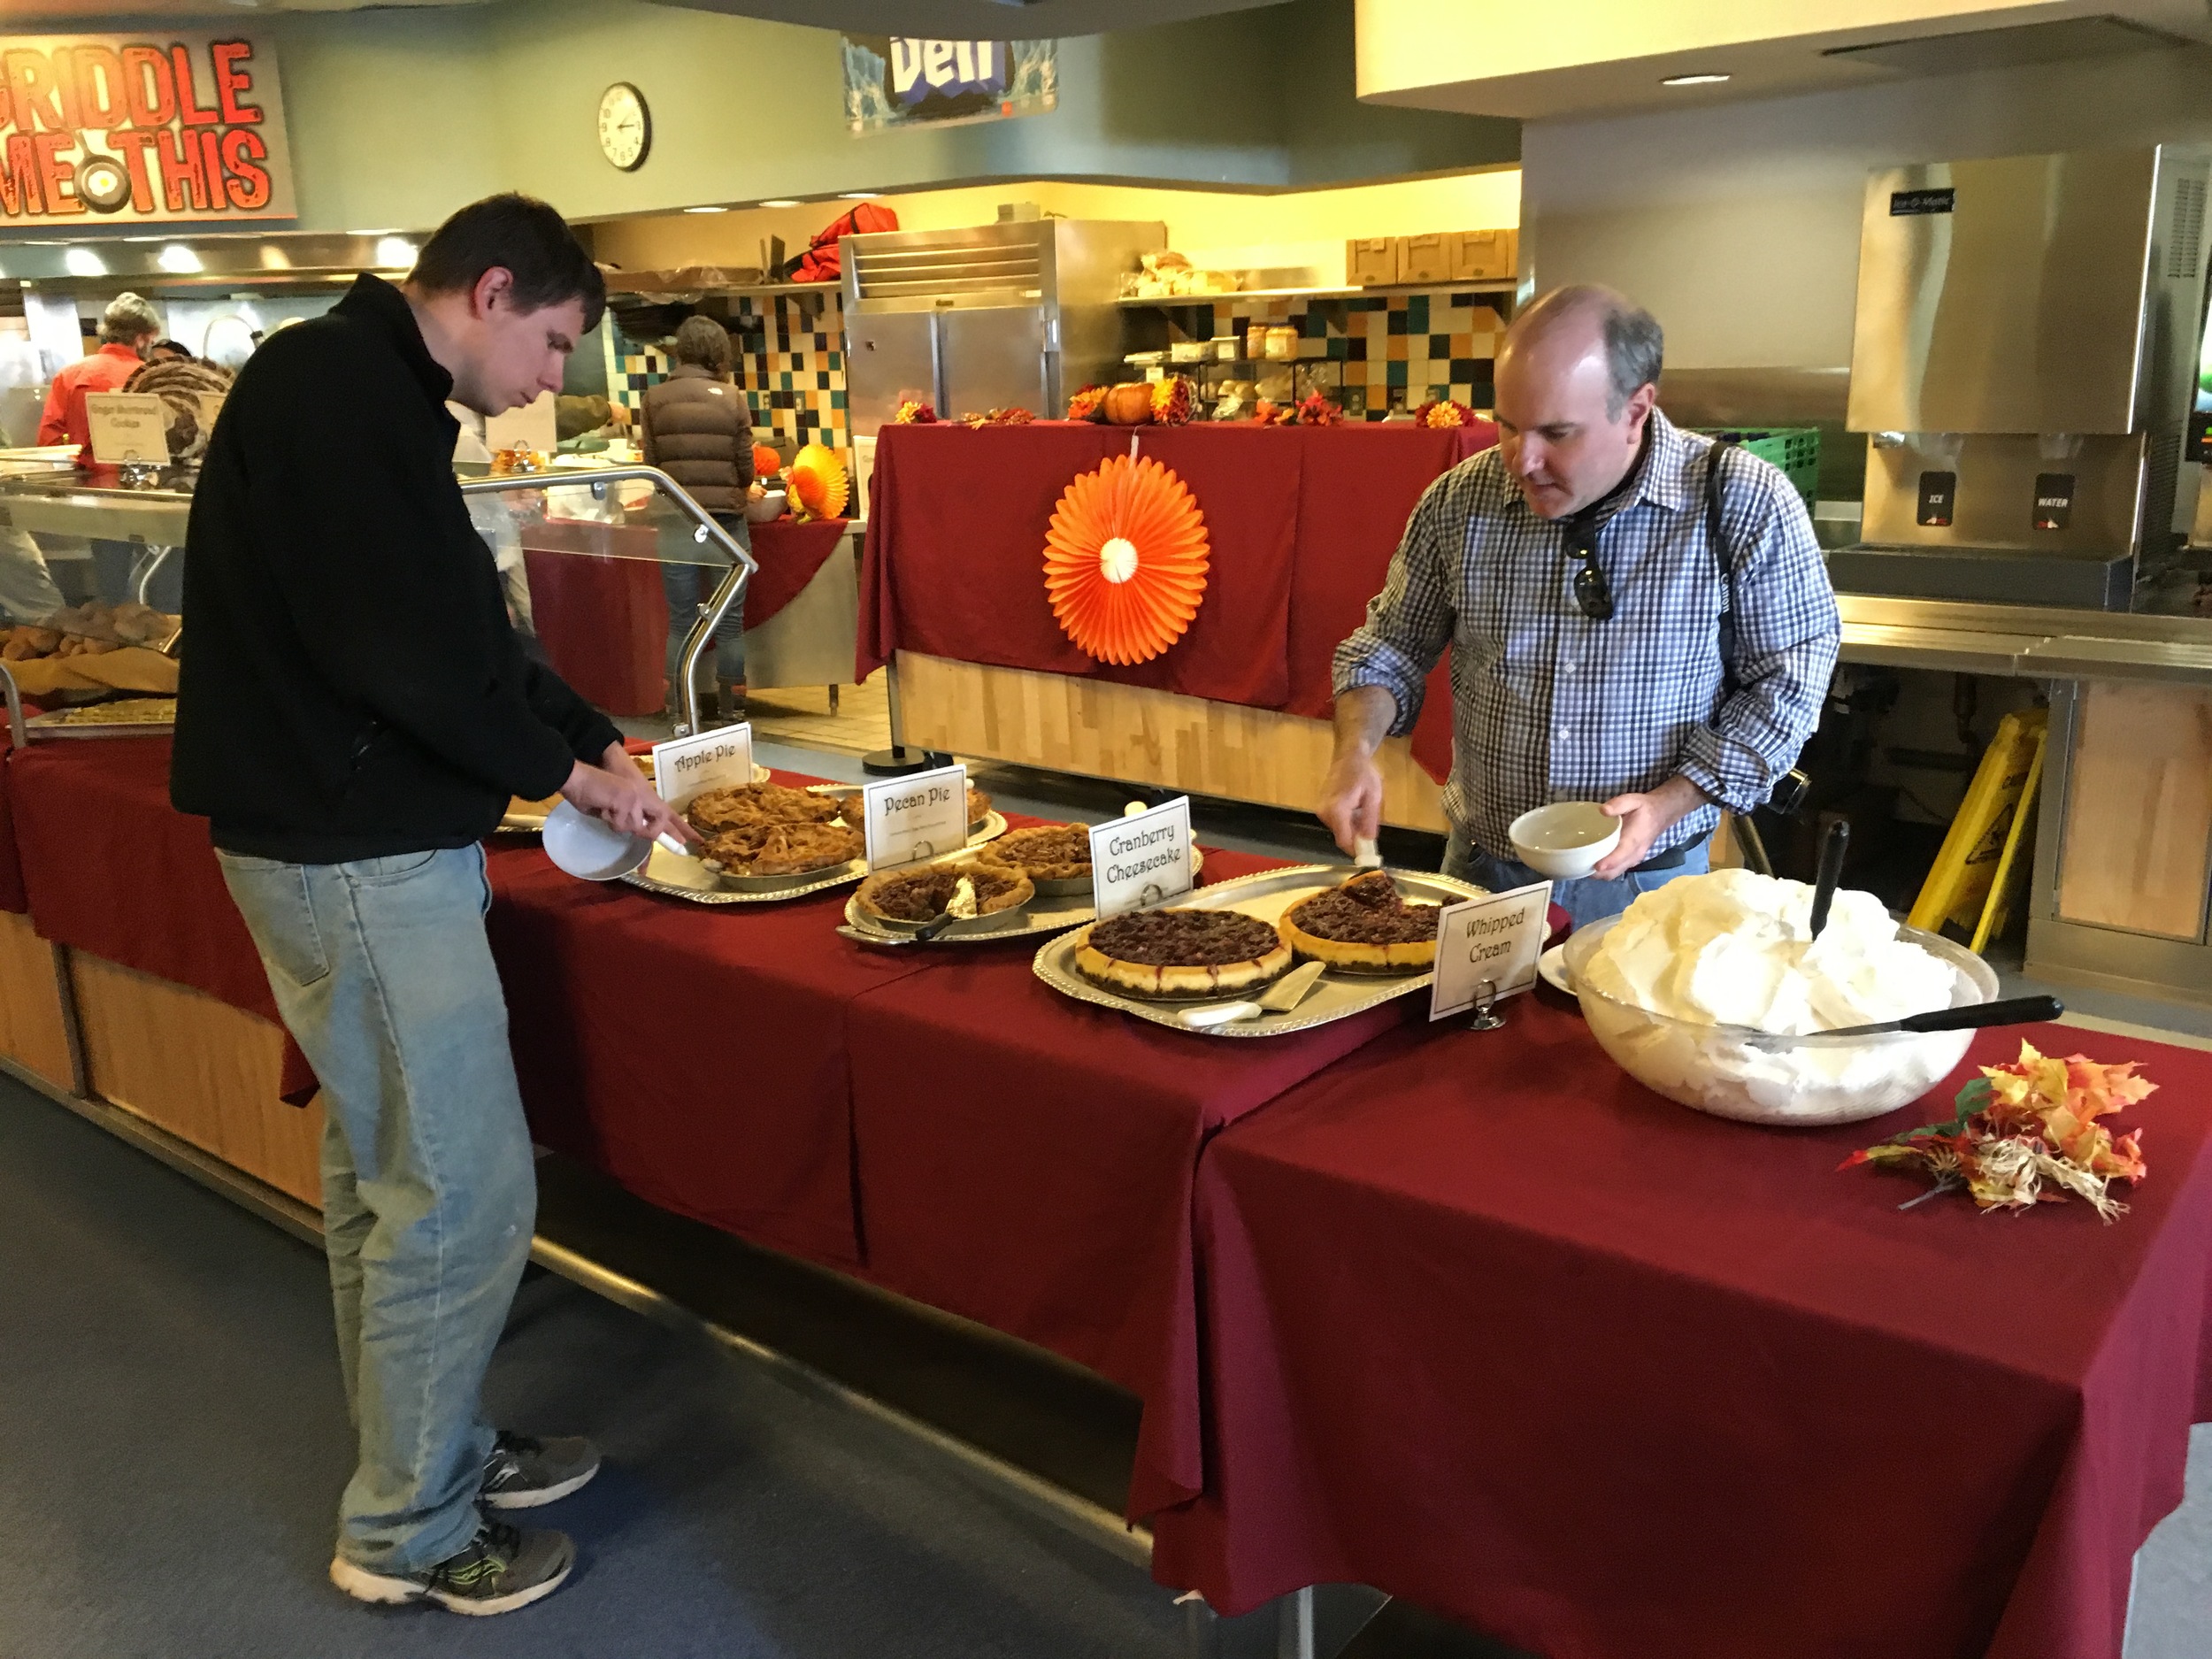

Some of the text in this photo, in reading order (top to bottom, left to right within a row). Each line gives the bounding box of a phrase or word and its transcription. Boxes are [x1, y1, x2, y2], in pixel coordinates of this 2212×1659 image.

[0, 42, 263, 132] RIDDLE
[602, 122, 608, 133] 9
[605, 136, 611, 148] 8
[612, 147, 618, 157] 7
[628, 147, 634, 157] 5
[620, 150, 626, 162] 6
[107, 128, 271, 212] THIS
[1929, 495, 1945, 504] ICE
[2038, 497, 2069, 508] WATER
[1720, 572, 1731, 613] Canon
[674, 744, 735, 772] Apple Pie
[884, 787, 950, 816] Pecan Pie
[1110, 825, 1175, 856] Cranberry
[1107, 848, 1181, 884] Cheesecake
[1466, 907, 1525, 938] Whipped
[1469, 940, 1512, 963] Cream
